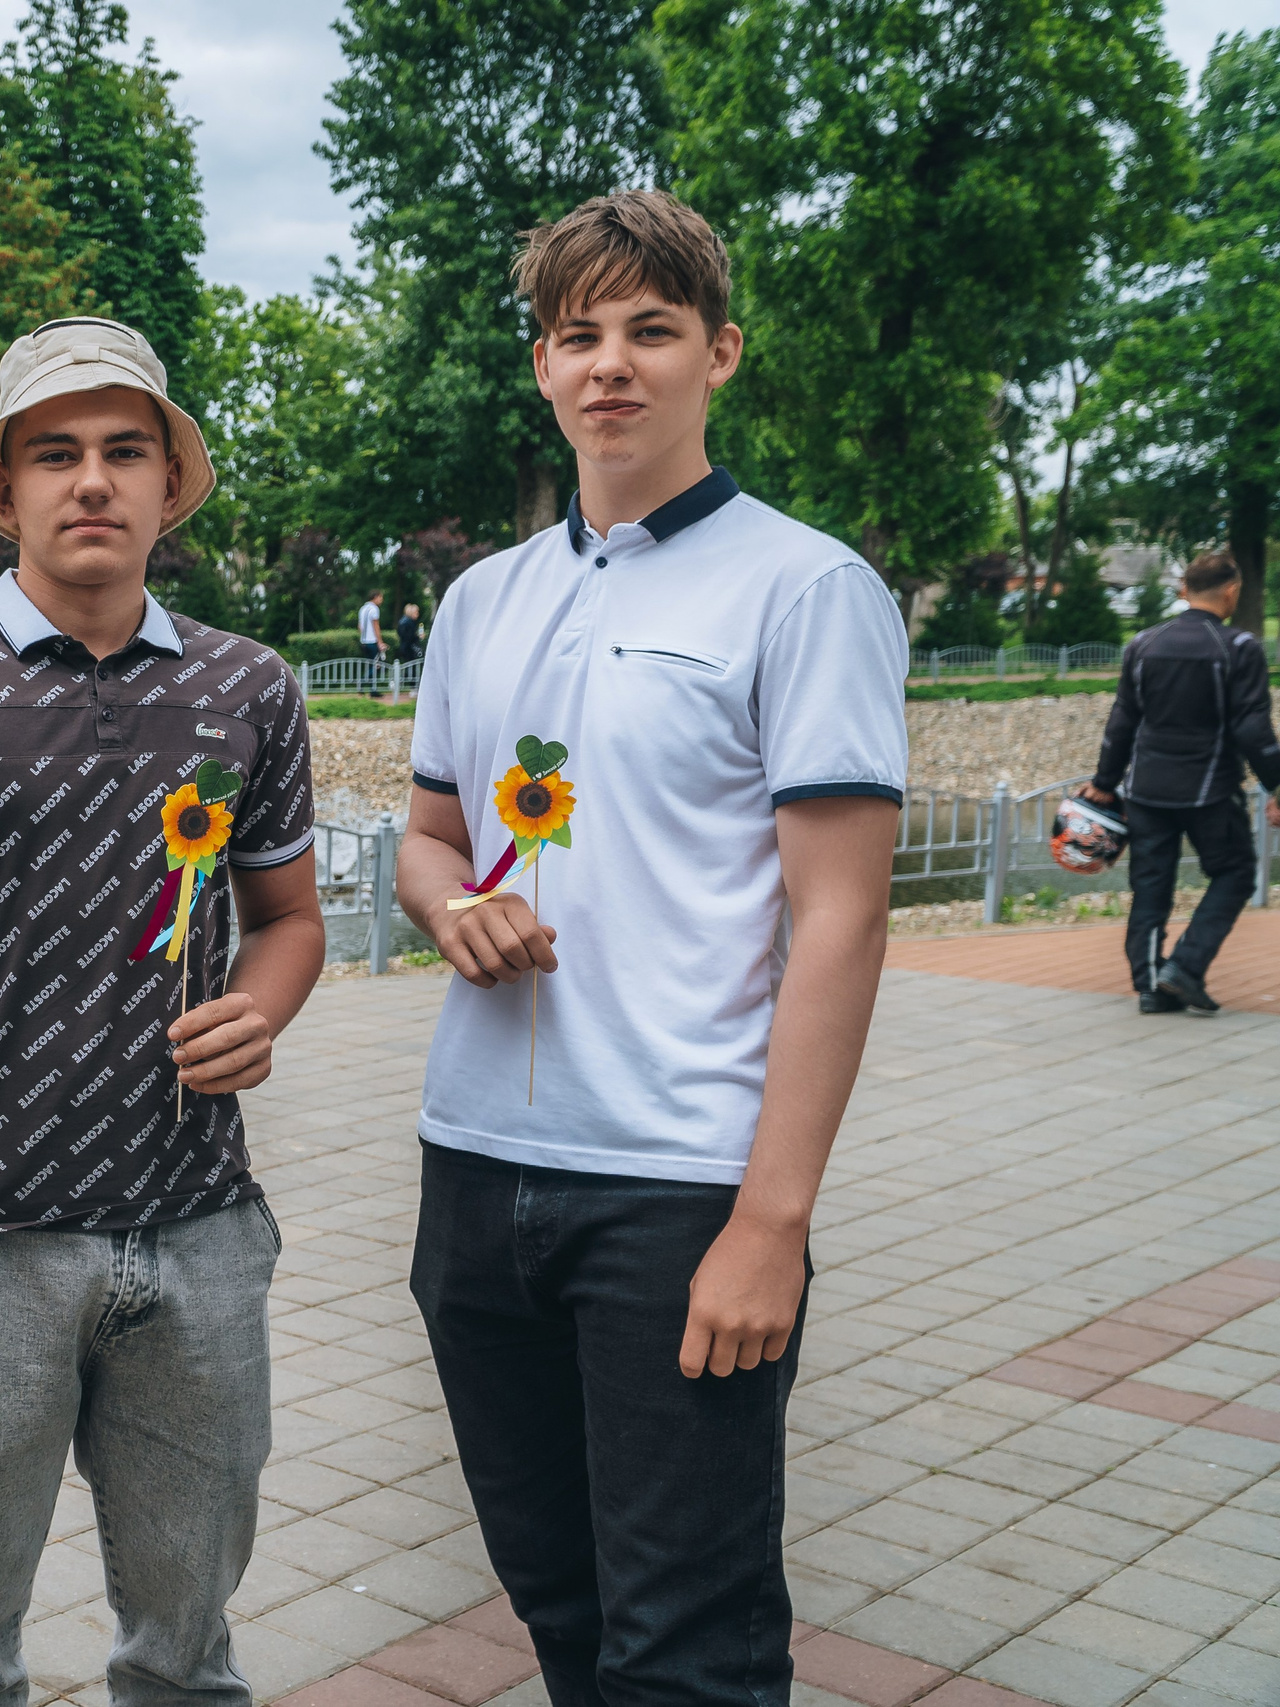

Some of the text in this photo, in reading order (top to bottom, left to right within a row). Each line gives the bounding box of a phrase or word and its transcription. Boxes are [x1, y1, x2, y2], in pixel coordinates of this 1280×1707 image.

[208, 637, 239, 659] LACOSTE
[120, 656, 160, 684] LACOSTE
[173, 660, 207, 685] LACOSTE
[217, 666, 251, 694] LACOSTE
[33, 684, 66, 707] COSTE
[280, 697, 301, 748] LACOSTE
[277, 742, 306, 790] LACOSTE
[29, 782, 71, 825] LACOSTE
[78, 778, 120, 823] LACOSTE
[127, 782, 170, 824] LACOSTE
[280, 783, 307, 830] LACOSTE
[30, 828, 73, 872] LACOSTE
[78, 829, 121, 873] LACOSTE
[27, 877, 72, 920] LACOSTE
[78, 876, 121, 919] LACOSTE
[127, 878, 165, 919] LACOSTE
[26, 925, 72, 967] LACOSTE
[77, 926, 120, 970] LACOSTE
[22, 974, 67, 1016] LACOSTE
[74, 972, 119, 1015] LACOSTE
[122, 972, 163, 1016] LACOSTE
[20, 1019, 65, 1061] LACOSTE
[71, 1021, 114, 1064] LACOSTE
[122, 1018, 163, 1061] LACOSTE
[18, 1068, 62, 1110] LACOSTE
[70, 1065, 115, 1108] LACOSTE
[122, 1065, 162, 1109] LACOSTE
[17, 1113, 63, 1156] LACOSTE
[69, 1114, 114, 1156] LACOSTE
[124, 1110, 162, 1154] LACOSTE
[14, 1161, 60, 1202] LACOSTE
[69, 1157, 115, 1200] LACOSTE
[123, 1158, 160, 1201] LACOSTE
[164, 1149, 196, 1193] LACOSTE
[205, 1147, 230, 1187] LACOSTE
